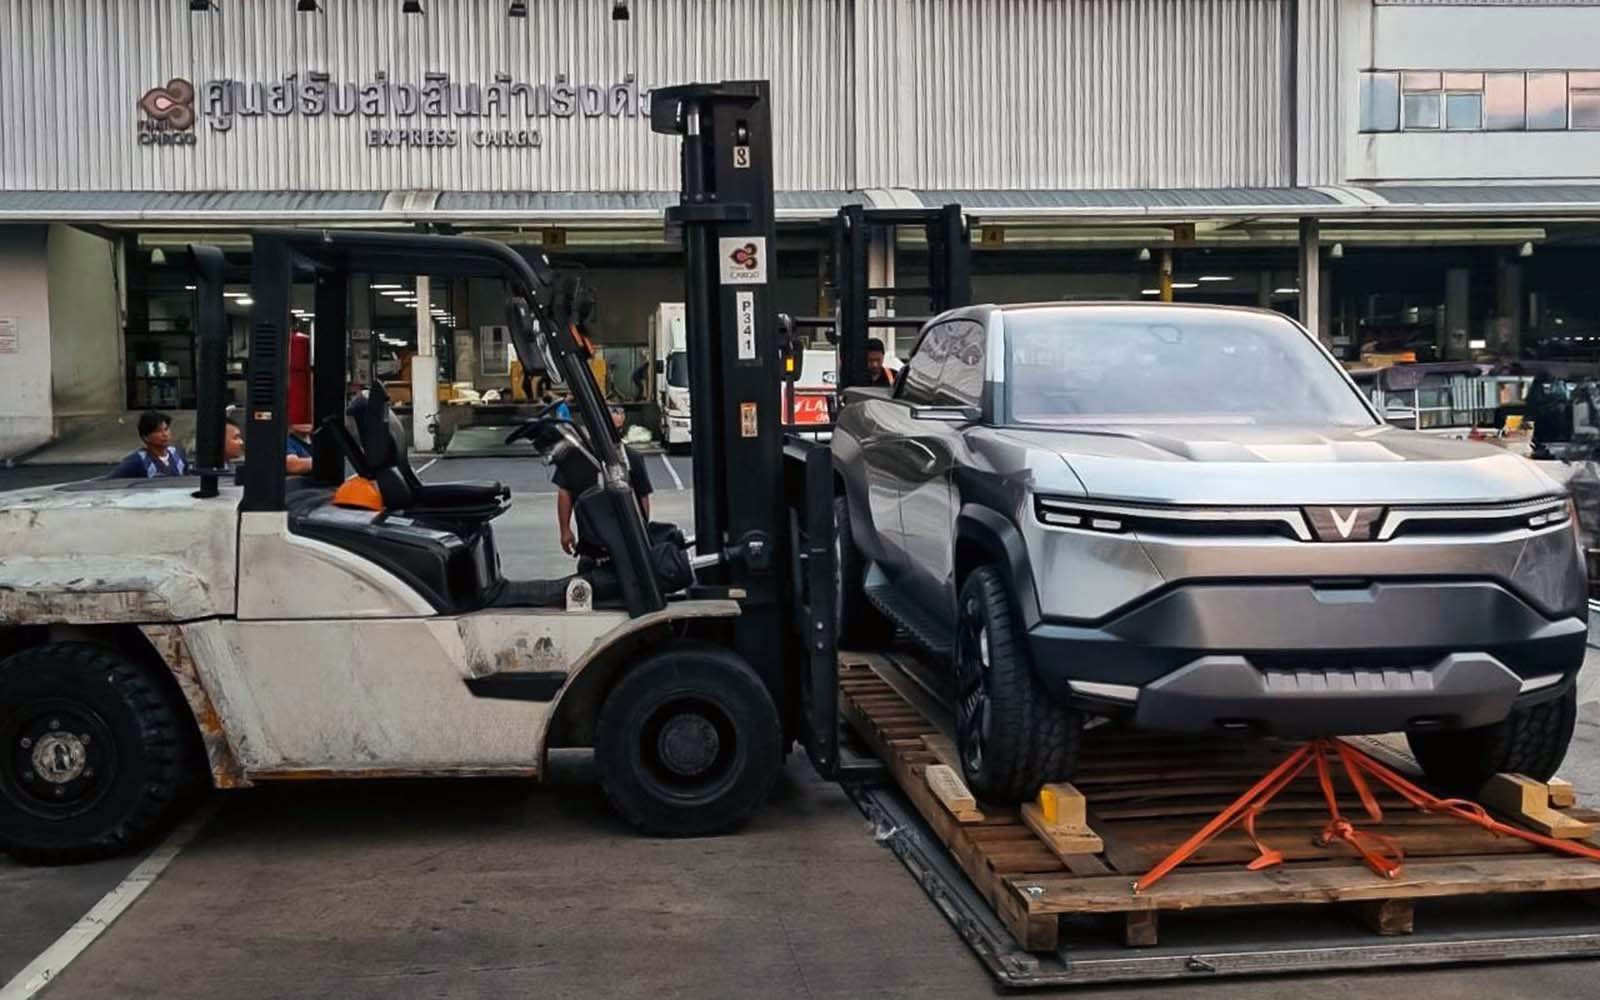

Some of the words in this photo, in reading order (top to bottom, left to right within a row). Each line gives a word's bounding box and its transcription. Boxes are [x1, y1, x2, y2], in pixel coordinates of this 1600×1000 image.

[137, 132, 196, 145] CARGO
[366, 128, 458, 147] EXPRESS
[472, 128, 543, 147] CARGO
